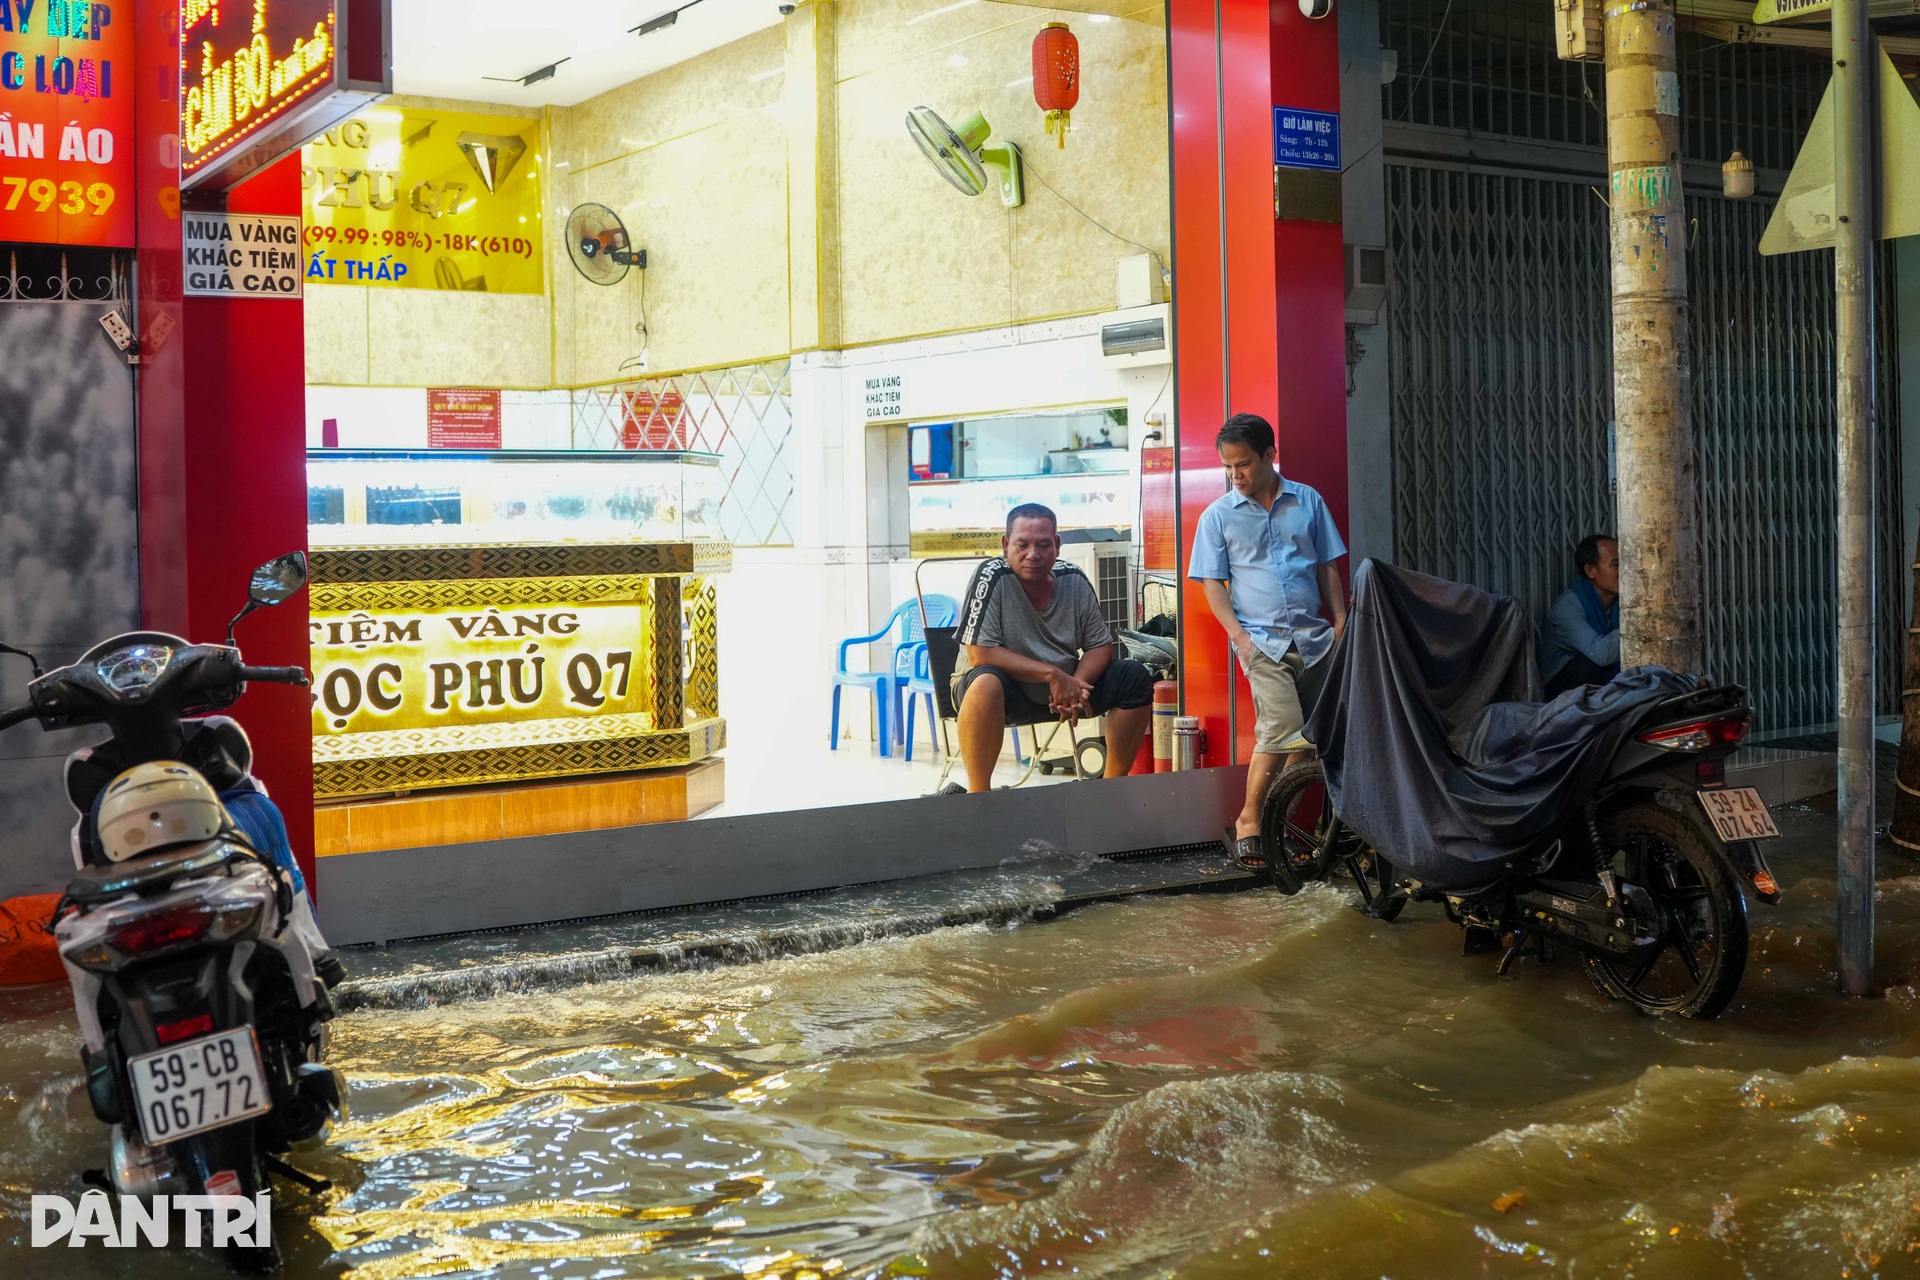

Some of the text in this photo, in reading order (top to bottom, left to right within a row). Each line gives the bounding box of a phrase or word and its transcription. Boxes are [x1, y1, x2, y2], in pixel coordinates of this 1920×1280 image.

[35, 54, 111, 103] LOẠI
[1297, 117, 1313, 131] LÀM
[1314, 119, 1331, 135] VIỆC
[58, 120, 113, 164] ÁO
[3, 176, 115, 216] 7939
[409, 179, 469, 220] Q7
[187, 219, 297, 245] MUA VÀNG
[187, 244, 296, 274] KHÁC TIỆM
[344, 254, 408, 281] THẤP
[189, 269, 296, 293] GIÁ CAO
[865, 379, 880, 389] MUA
[883, 405, 901, 416] CAO
[446, 609, 581, 638] VÀNG
[430, 643, 545, 709] PHÚ
[566, 651, 632, 707] Q7
[1708, 789, 1759, 813] 59-ZA
[1718, 813, 1776, 838] 074.64
[149, 1038, 239, 1093] 59-CB
[150, 1075, 258, 1135] 067.72
